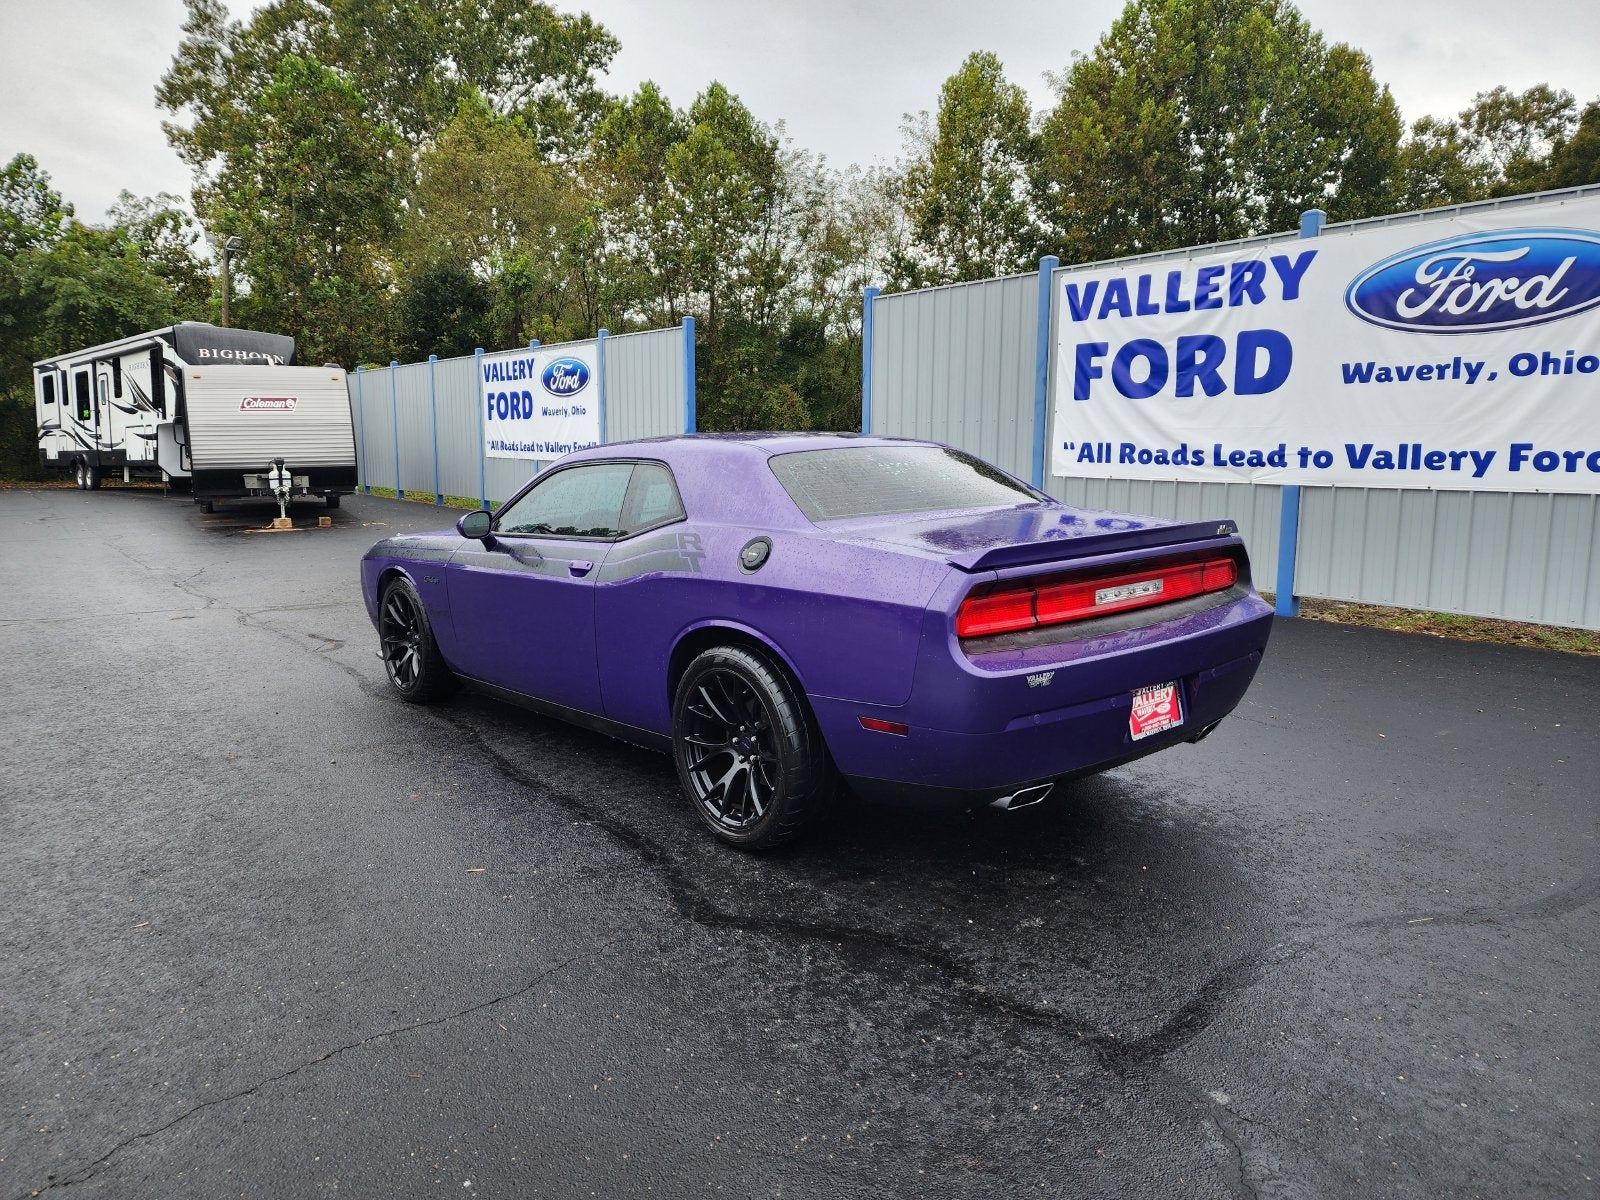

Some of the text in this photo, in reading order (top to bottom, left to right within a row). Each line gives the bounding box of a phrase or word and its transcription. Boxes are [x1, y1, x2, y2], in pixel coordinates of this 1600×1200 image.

[1066, 250, 1318, 322] VALLERY
[1396, 247, 1577, 319] Ford
[483, 358, 535, 382] VALLERY
[550, 363, 581, 390] Ford
[1073, 329, 1294, 401] FORD
[1342, 350, 1600, 385] Waverly, Ohio
[243, 398, 286, 409] Coleman
[487, 390, 533, 421] FORD
[571, 405, 587, 415] Ohio
[500, 441, 519, 451] Roads
[520, 441, 535, 452] Lead
[537, 442, 544, 452] to
[545, 441, 571, 454] Vallery
[1119, 443, 1205, 467] Roads
[1213, 443, 1288, 468] Lead
[1297, 446, 1334, 469] to
[1344, 443, 1497, 478] Vallery
